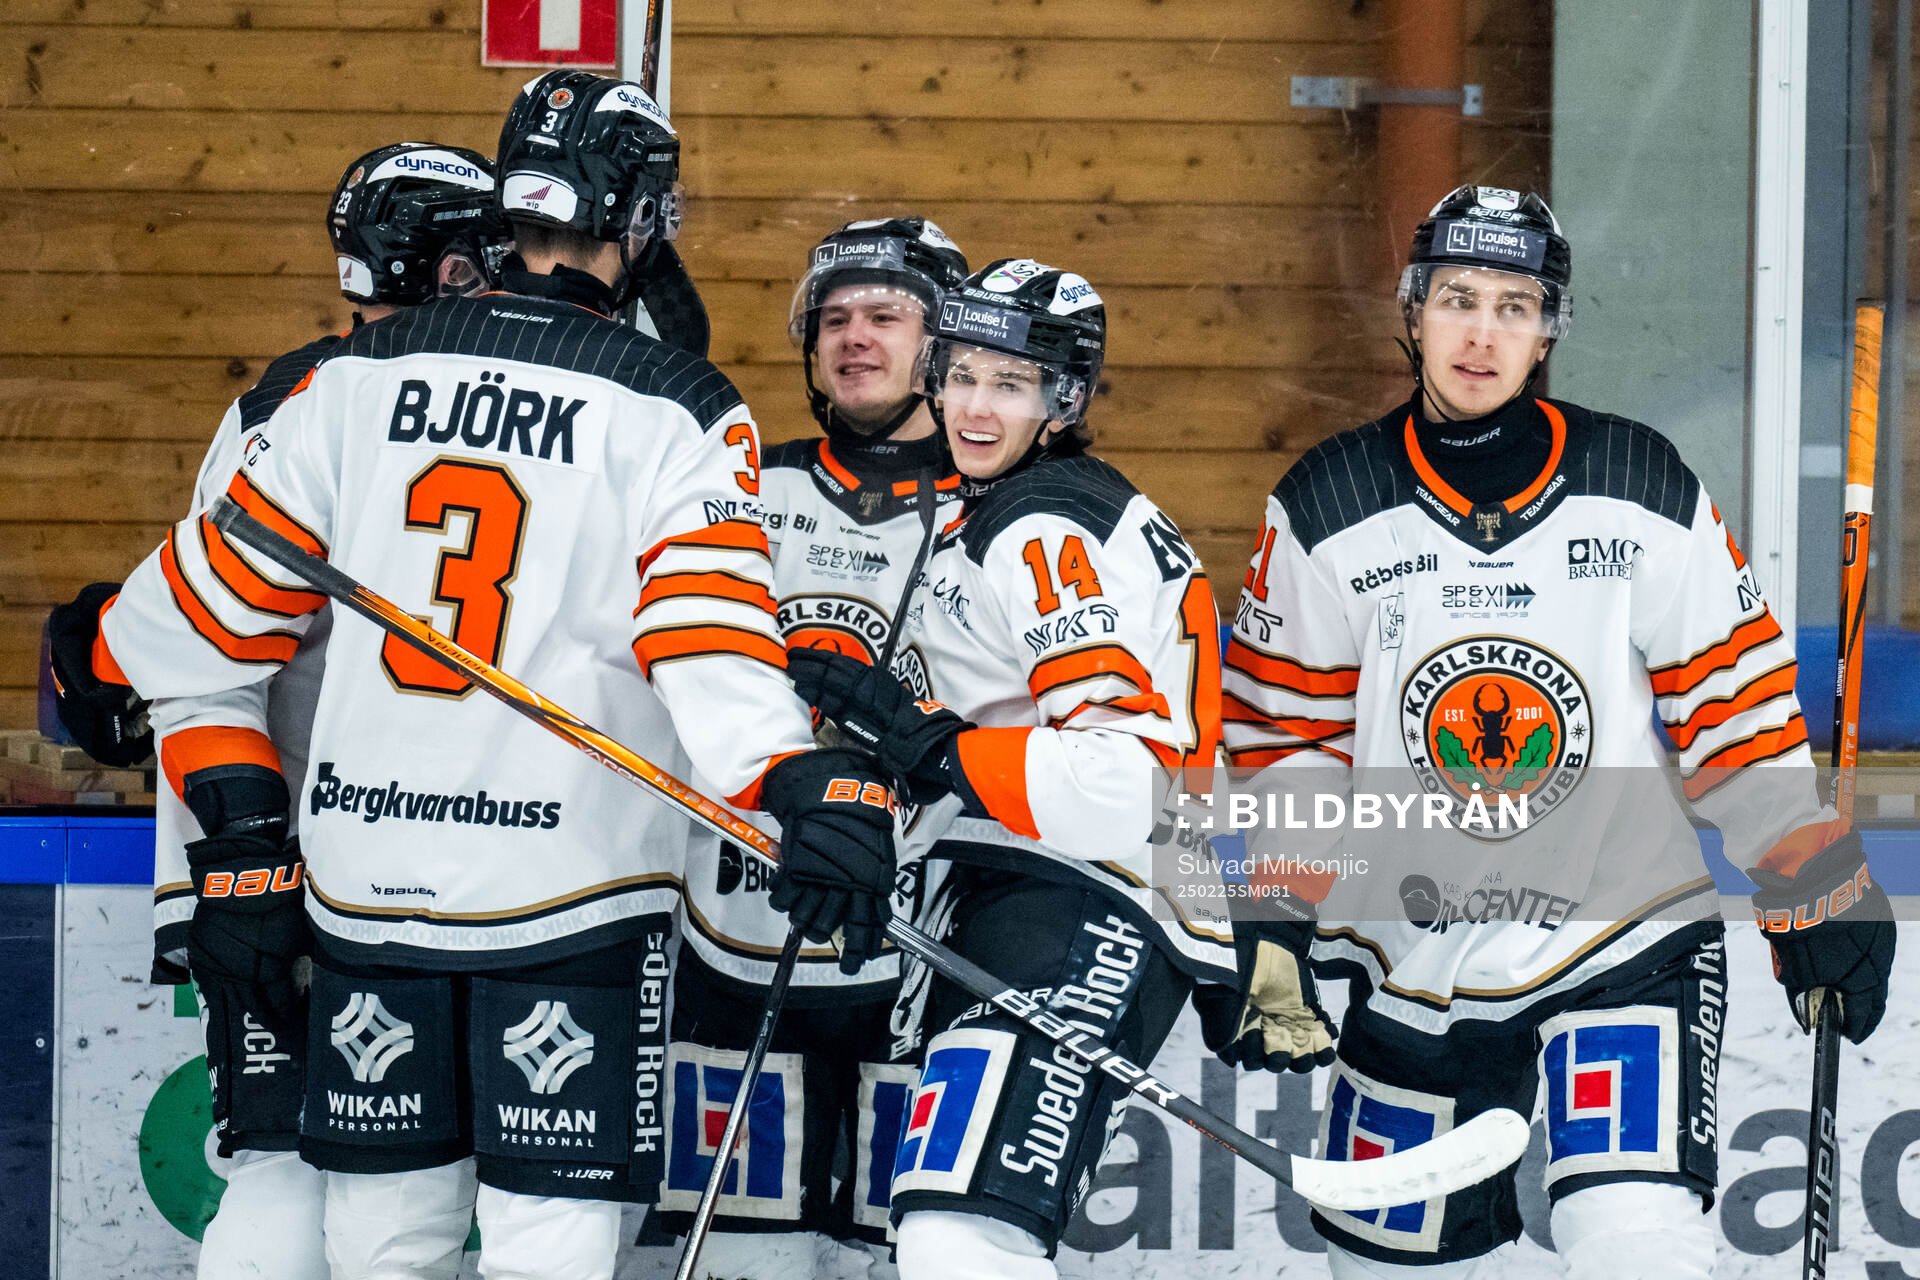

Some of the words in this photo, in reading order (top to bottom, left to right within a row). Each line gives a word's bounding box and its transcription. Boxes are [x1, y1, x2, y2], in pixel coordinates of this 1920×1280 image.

[617, 90, 669, 121] dynacon
[541, 111, 559, 132] 3
[395, 156, 479, 180] dynacon
[335, 191, 352, 215] 23
[840, 244, 875, 256] Louise
[877, 242, 886, 254] L
[1478, 230, 1518, 247] Louise
[1520, 236, 1528, 249] L
[965, 307, 1000, 327] Louise
[1001, 316, 1010, 330] L
[387, 370, 588, 465] BJÖRK
[1440, 427, 1501, 447] BAUER
[724, 423, 761, 497] 3
[1416, 485, 1460, 527] TEAMGEAR
[1520, 474, 1566, 520] TEAMGEAR
[793, 513, 818, 534] Bil
[380, 454, 532, 702] 3
[1022, 534, 1104, 617] 14
[1475, 560, 1515, 569] BAUER
[776, 601, 890, 652] RLSKRO
[1023, 604, 1119, 658] NKT
[1406, 644, 1582, 718] KARLSKRONA
[1445, 709, 1466, 722] EST.
[1516, 706, 1543, 720] 2001
[844, 720, 879, 744] BAUER
[311, 762, 562, 830] Bergkvarabuss
[654, 773, 781, 857] HYPERLIT
[1055, 914, 1145, 1020] Rock
[991, 988, 1180, 1108] BAUER
[1689, 978, 1723, 1152] Sweden
[327, 1089, 422, 1118] WIKAN
[634, 1046, 665, 1153] Rock
[329, 1118, 421, 1131] PERSONAL
[498, 1104, 596, 1134] WIKAN
[501, 1132, 594, 1148] PERSONAL
